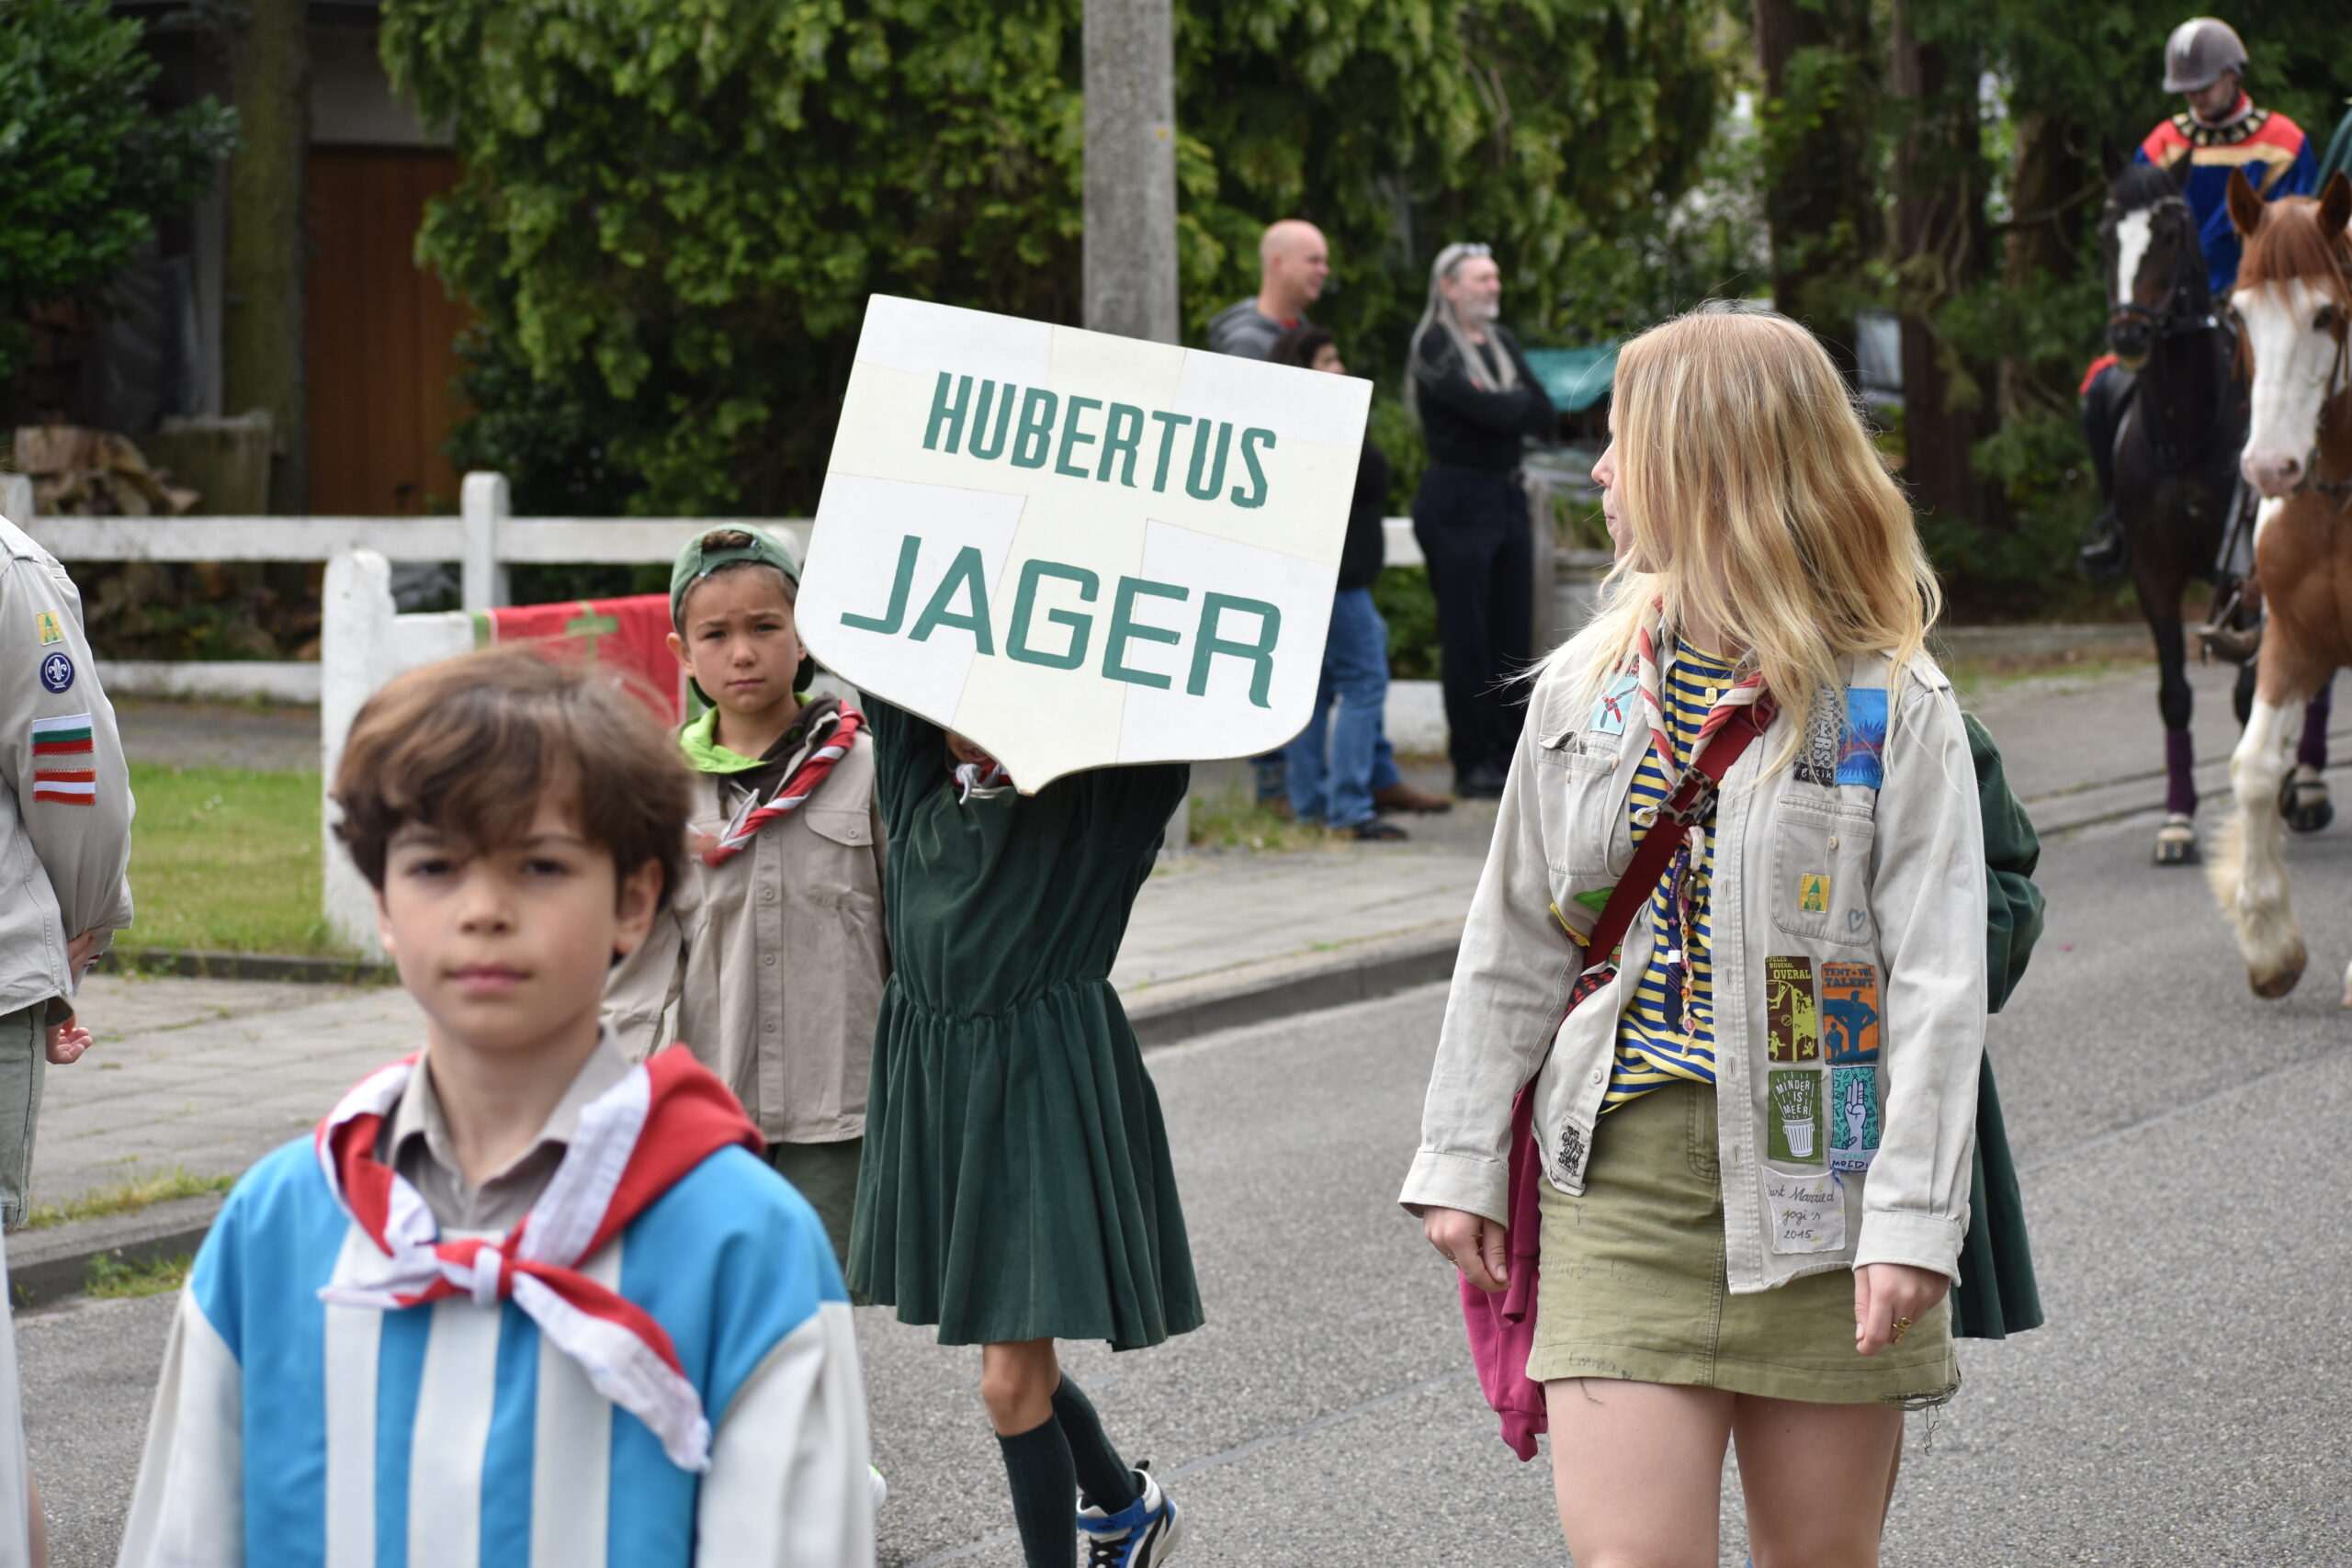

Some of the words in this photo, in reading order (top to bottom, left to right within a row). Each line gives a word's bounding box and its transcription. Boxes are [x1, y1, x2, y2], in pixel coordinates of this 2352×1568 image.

[922, 371, 1276, 509] HUBERTUS
[840, 535, 1282, 709] JAGER
[1773, 969, 1812, 980] OVERAL
[1776, 1079, 1811, 1095] MINDER
[1793, 1092, 1803, 1103] IS
[1782, 1104, 1808, 1116] MEER
[1832, 1160, 1870, 1169] MOEDI
[1783, 1229, 1815, 1240] 2015
